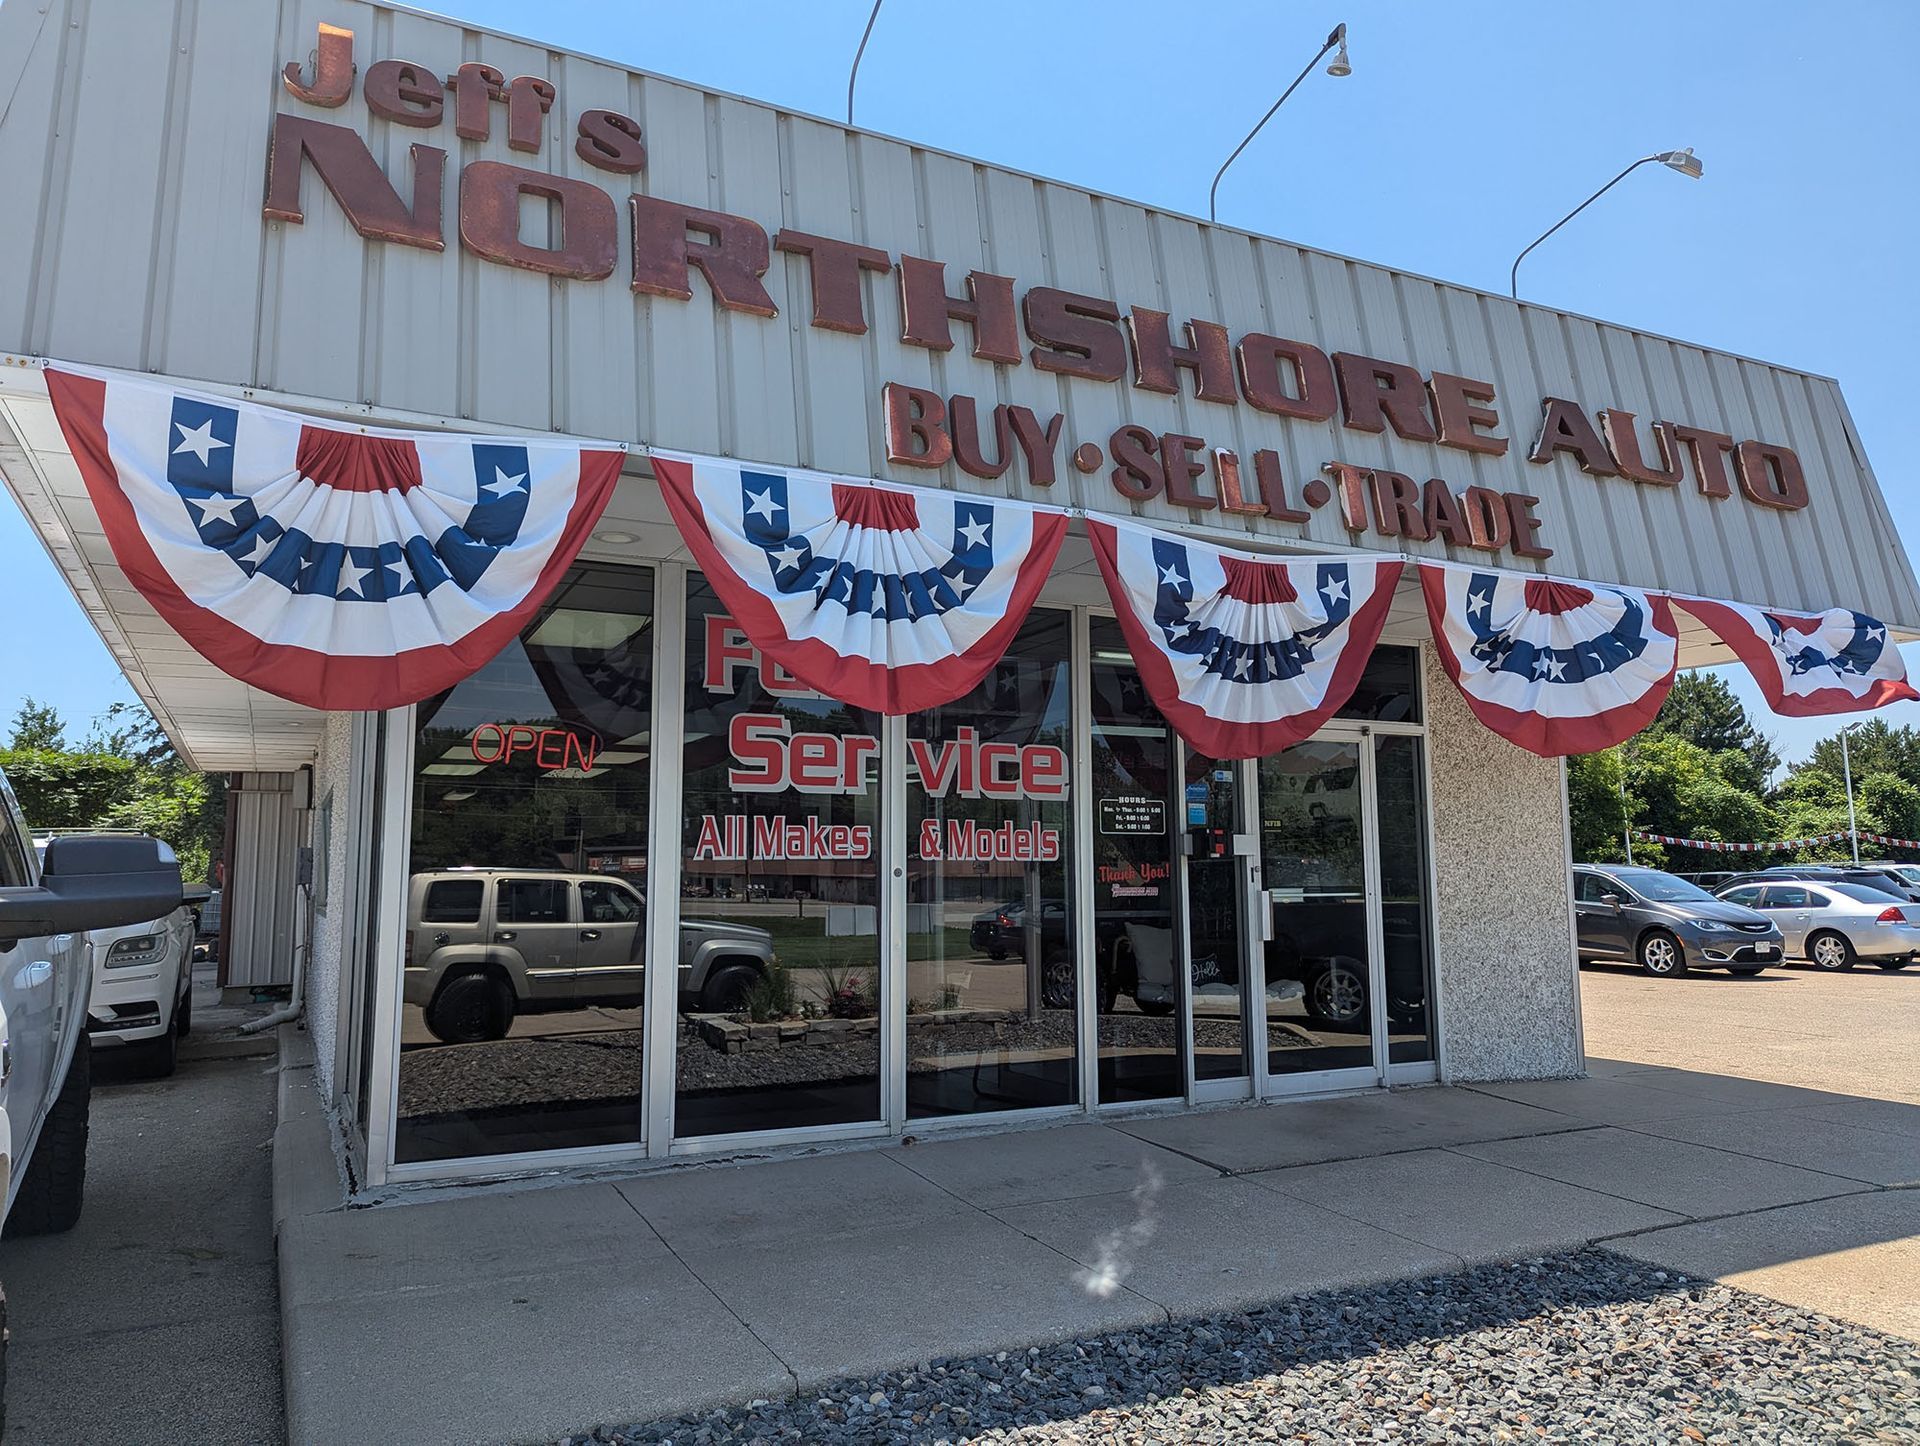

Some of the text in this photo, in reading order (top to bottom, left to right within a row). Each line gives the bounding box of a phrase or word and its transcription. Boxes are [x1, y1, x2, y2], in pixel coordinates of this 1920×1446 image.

[263, 113, 1810, 511] NORTHSHORE AUTO
[882, 381, 1554, 560] BUY SELL TRADE
[471, 723, 597, 772] OPEN
[1118, 796, 1147, 804] HOURS
[693, 815, 1060, 863] All Makes & Models
[1098, 863, 1170, 883] Thank You!
